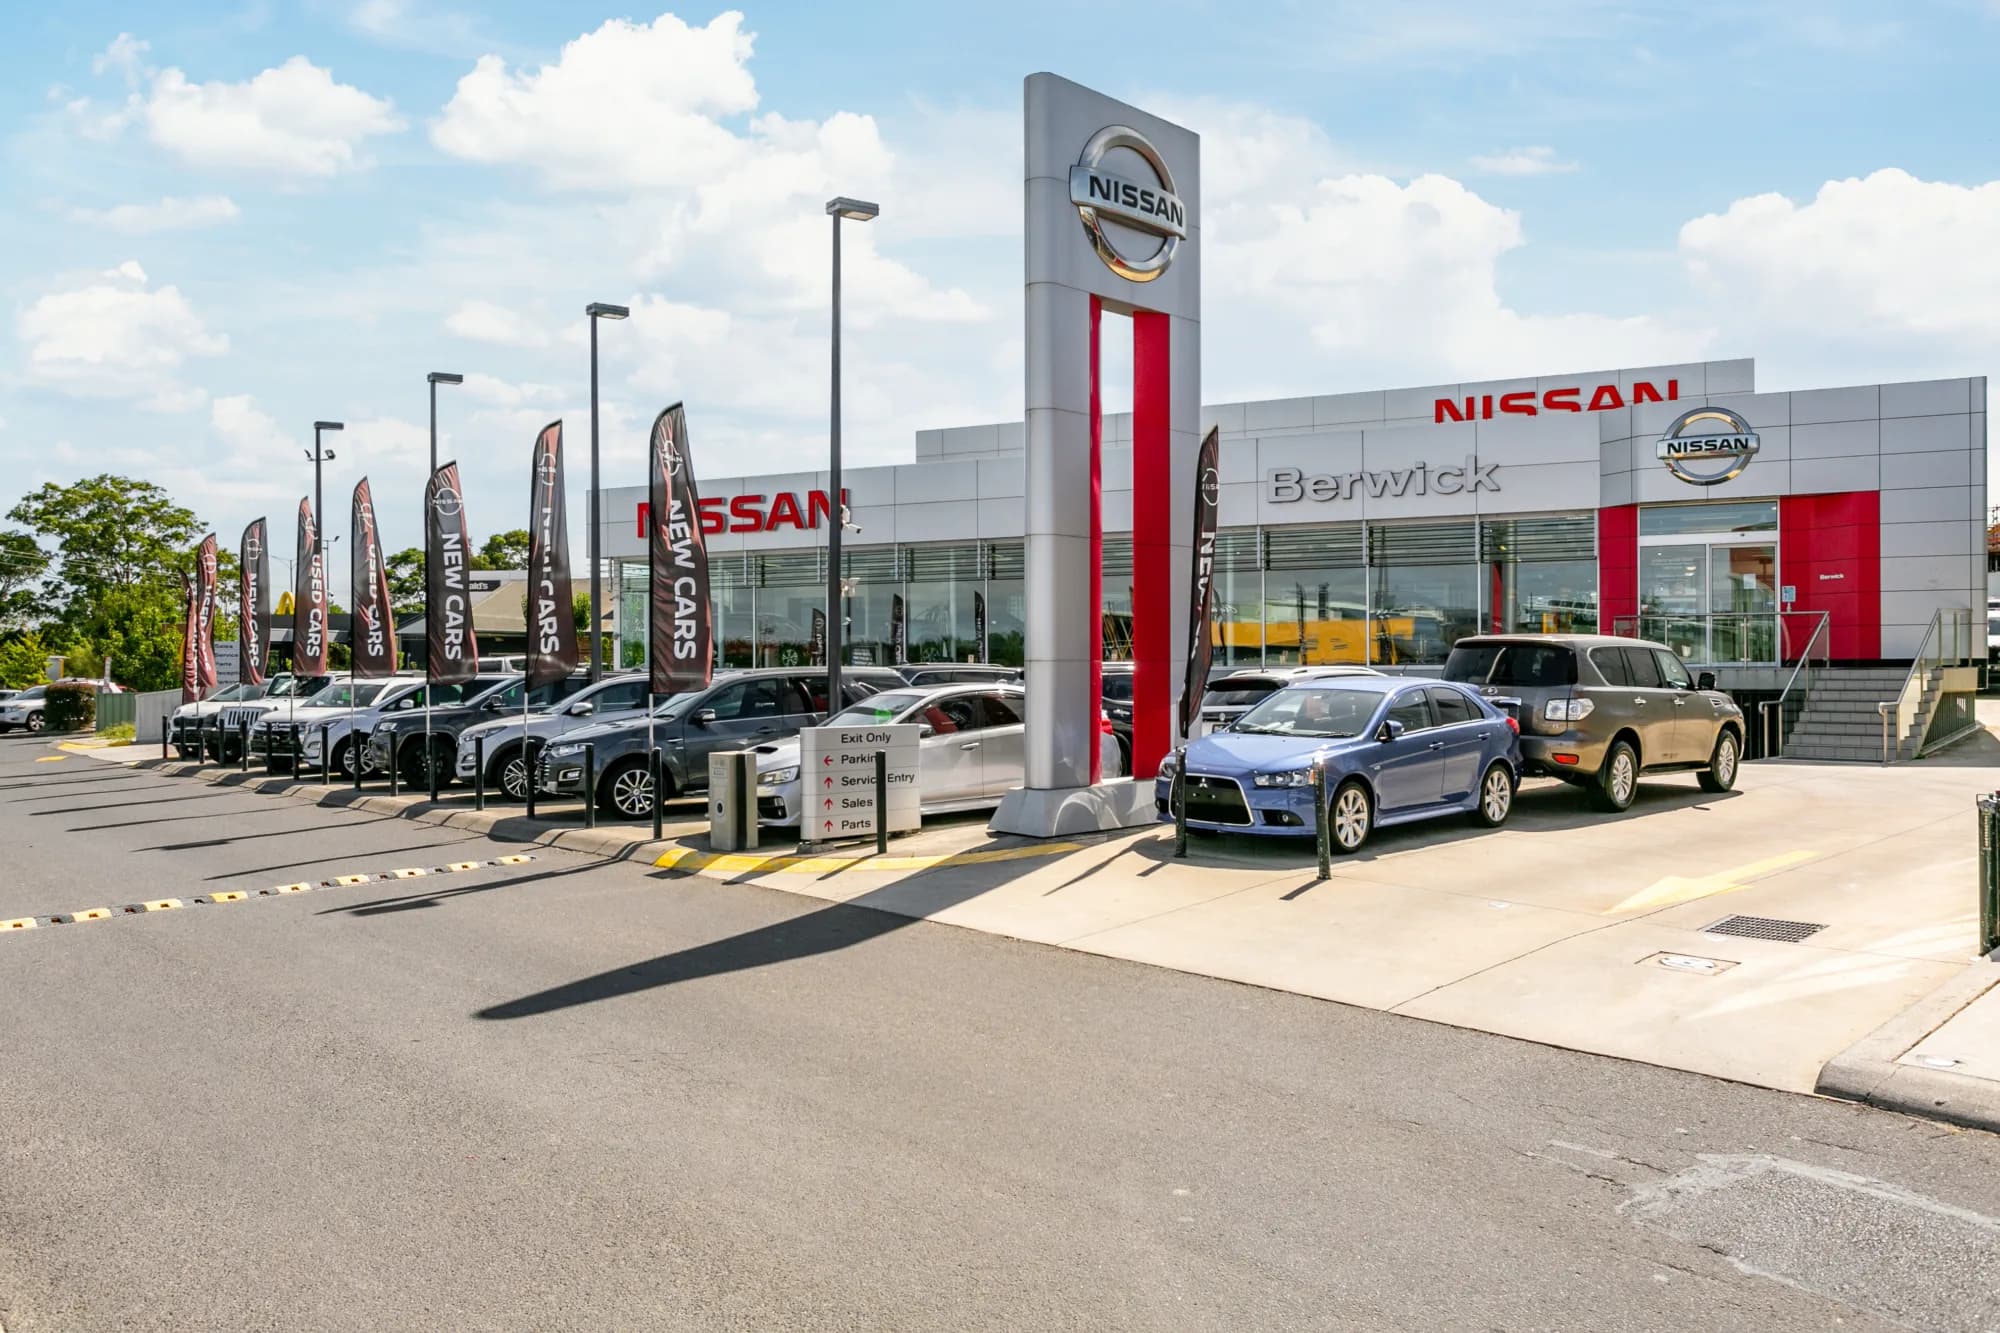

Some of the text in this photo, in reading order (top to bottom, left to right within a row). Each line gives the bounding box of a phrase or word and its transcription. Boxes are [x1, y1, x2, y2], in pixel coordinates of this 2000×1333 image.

[1089, 175, 1183, 228] NISSAN
[1434, 379, 1678, 423] NISSAN
[1667, 437, 1749, 455] NISSAN
[1267, 455, 1501, 503] Berwick
[441, 533, 464, 660] NEW CARS
[668, 499, 697, 660] NEW CARS
[1819, 573, 1845, 581] Berwick
[249, 573, 260, 667] NEW CARS
[306, 554, 323, 657] USED CARS
[538, 580, 560, 654] CARS
[367, 603, 384, 657] CARS
[841, 732, 891, 744] Exit Only
[841, 753, 877, 765] Parkin
[841, 773, 915, 786] Servic Entry
[841, 798, 873, 809] Sales
[841, 820, 872, 830] Parts
